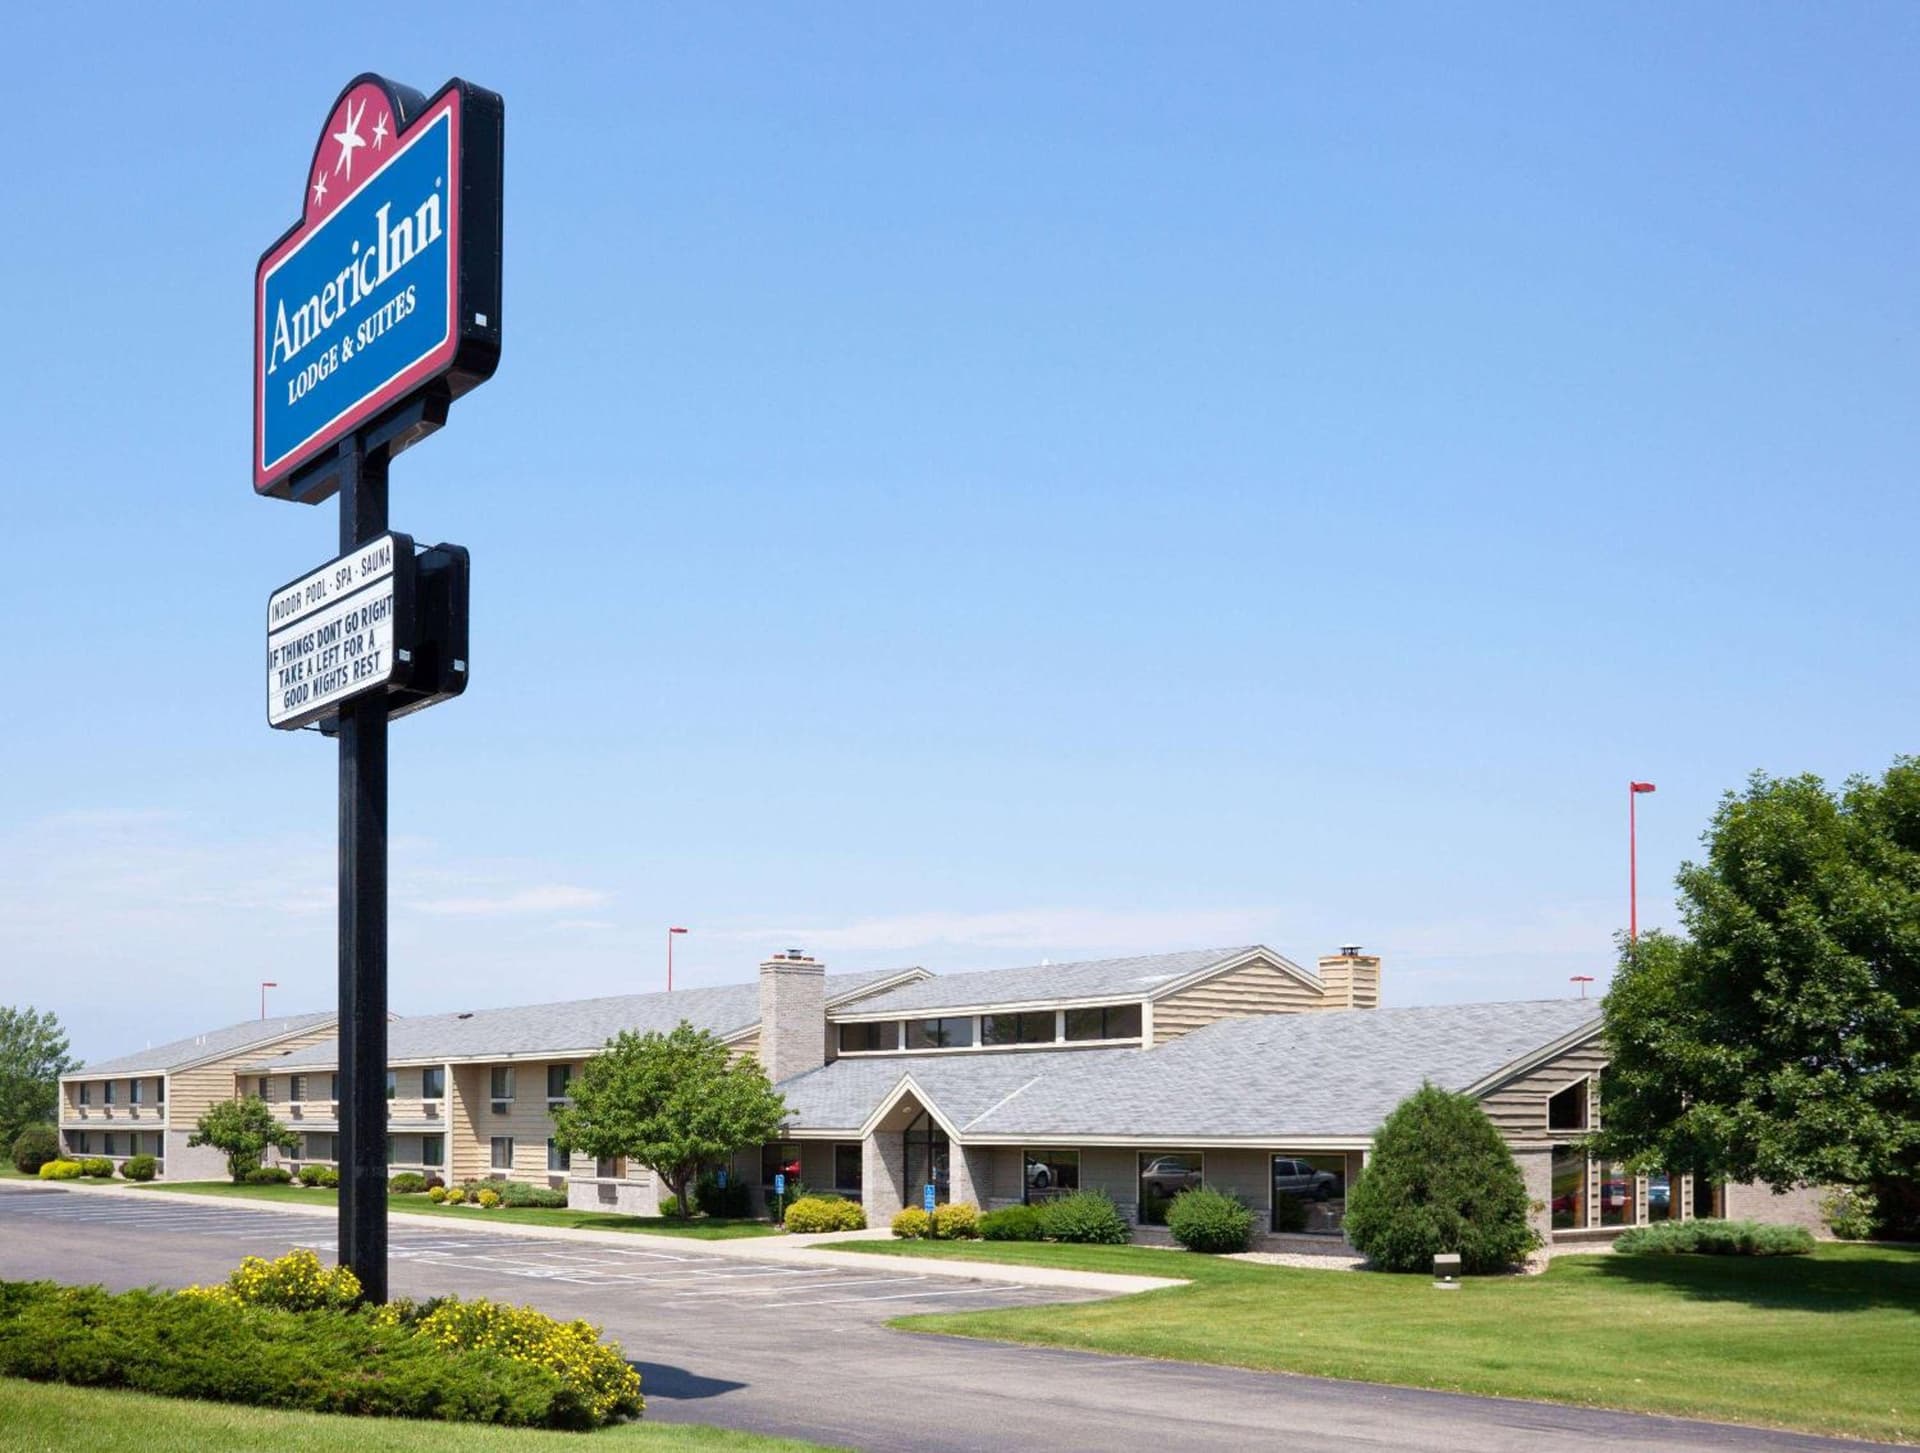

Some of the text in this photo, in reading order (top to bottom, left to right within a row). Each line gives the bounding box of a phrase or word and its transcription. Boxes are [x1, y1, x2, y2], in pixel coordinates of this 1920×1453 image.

[268, 192, 441, 375] AmericInn
[288, 284, 416, 406] LODGE & SUITES
[271, 545, 391, 623] INDOOR POOL SPA SAUNA
[269, 594, 393, 670] IF THINGS DONT GO RIGHT
[278, 628, 375, 688] TAKE A LEFT FOR A
[284, 650, 380, 708] GOOD NIGHTS REST
